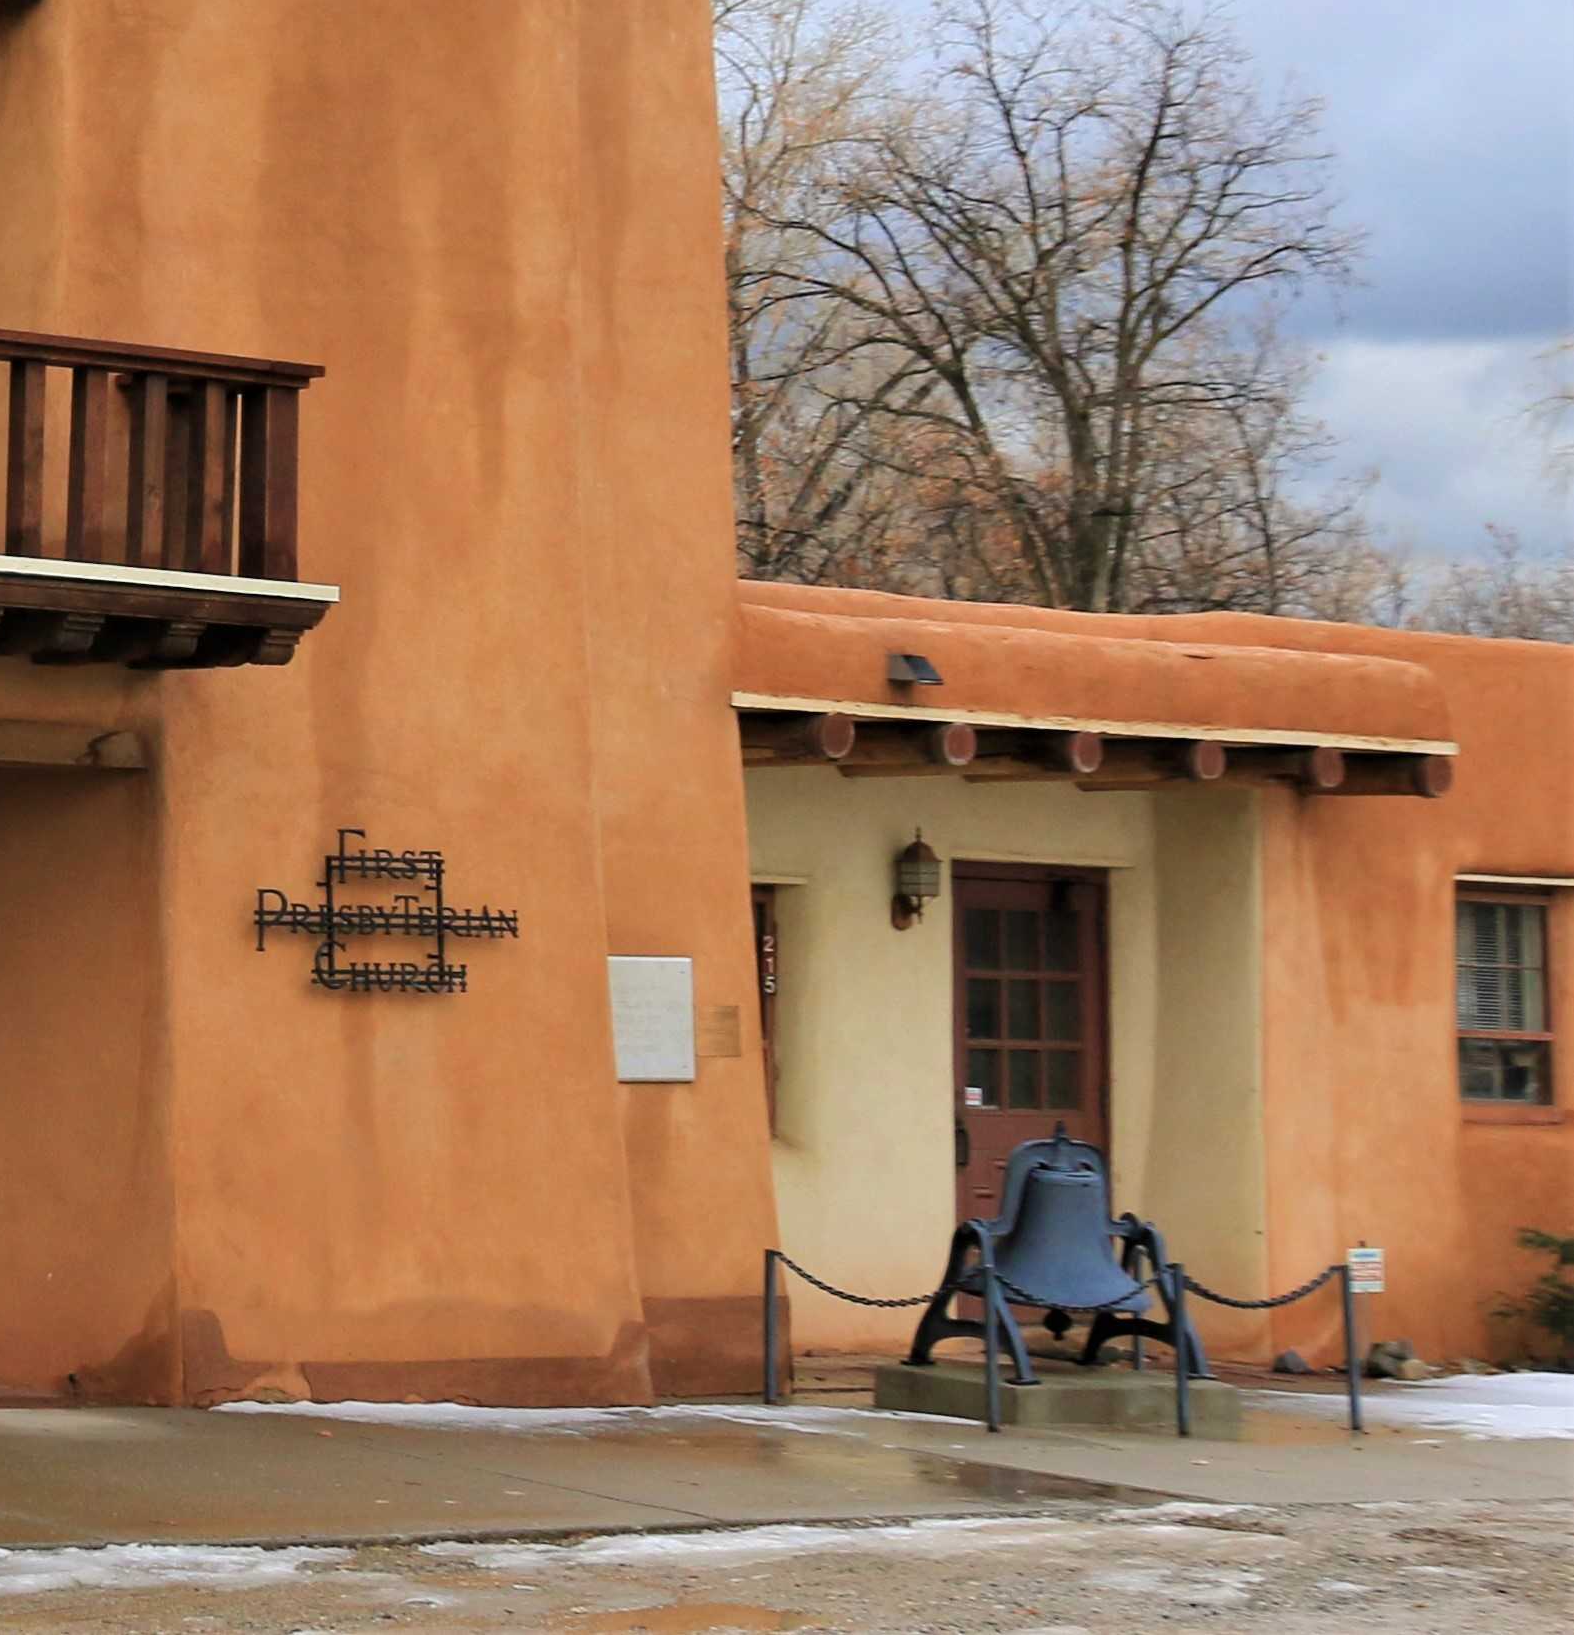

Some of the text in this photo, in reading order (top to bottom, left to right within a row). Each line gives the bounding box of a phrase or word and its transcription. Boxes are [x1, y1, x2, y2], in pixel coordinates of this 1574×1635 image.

[336, 829, 443, 884] FIRST
[255, 888, 520, 952] PRESBYTERIAN
[314, 941, 468, 993] CHURCH
[763, 935, 776, 994] 215
